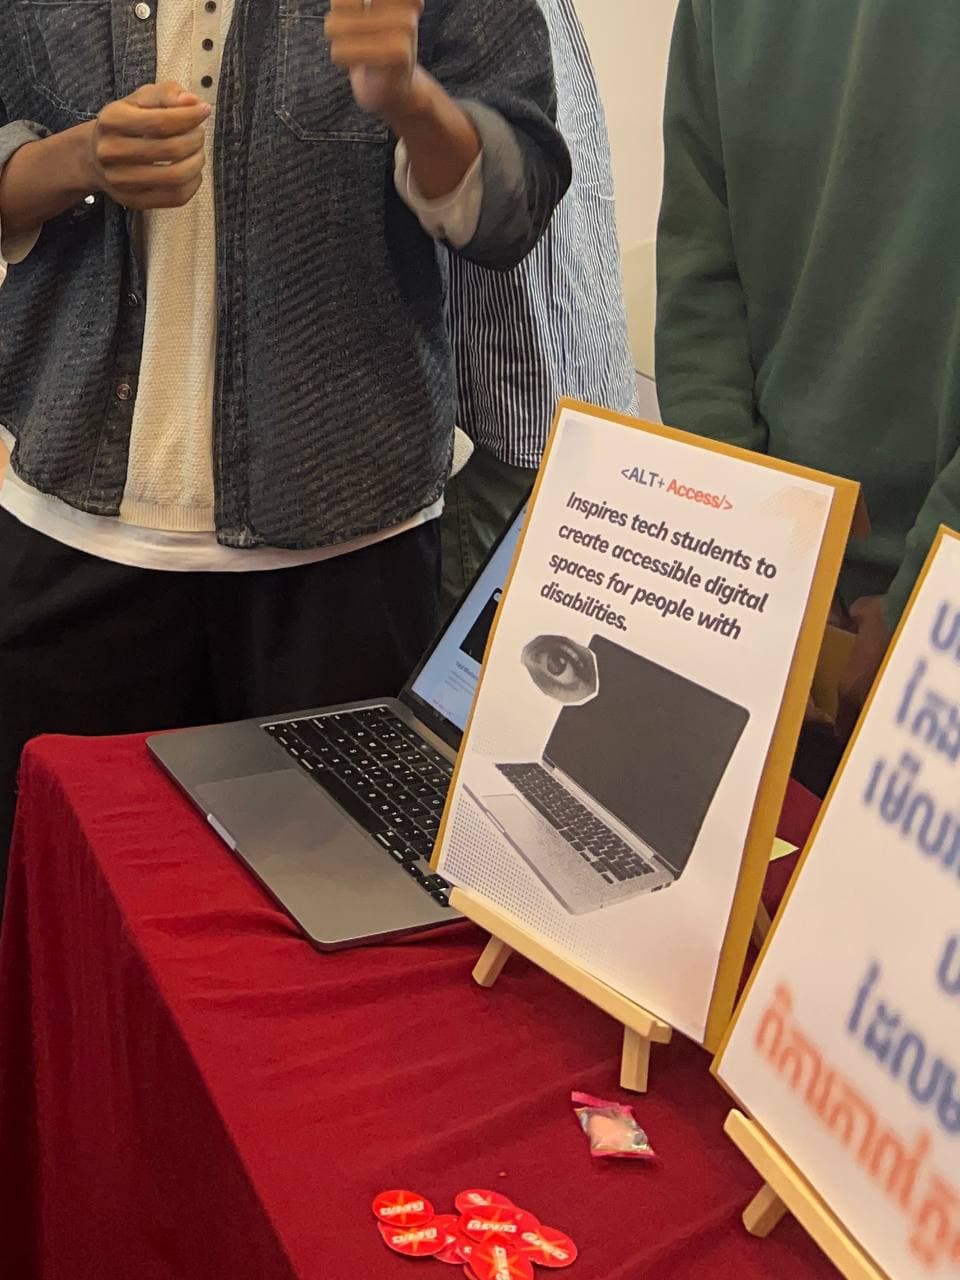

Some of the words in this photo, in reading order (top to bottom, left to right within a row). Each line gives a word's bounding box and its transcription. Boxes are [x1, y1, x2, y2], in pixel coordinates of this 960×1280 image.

[566, 491, 628, 527] Inspires
[631, 514, 668, 542] tech
[670, 530, 752, 570] students
[755, 557, 778, 579] to
[666, 479, 734, 511] Access/>
[540, 581, 628, 632] disabilities.
[549, 553, 604, 586] spaces
[606, 572, 633, 597] for
[630, 585, 695, 622] people
[697, 610, 742, 640] with
[558, 523, 610, 554] create
[611, 544, 702, 588] accessible
[704, 576, 769, 613] digital
